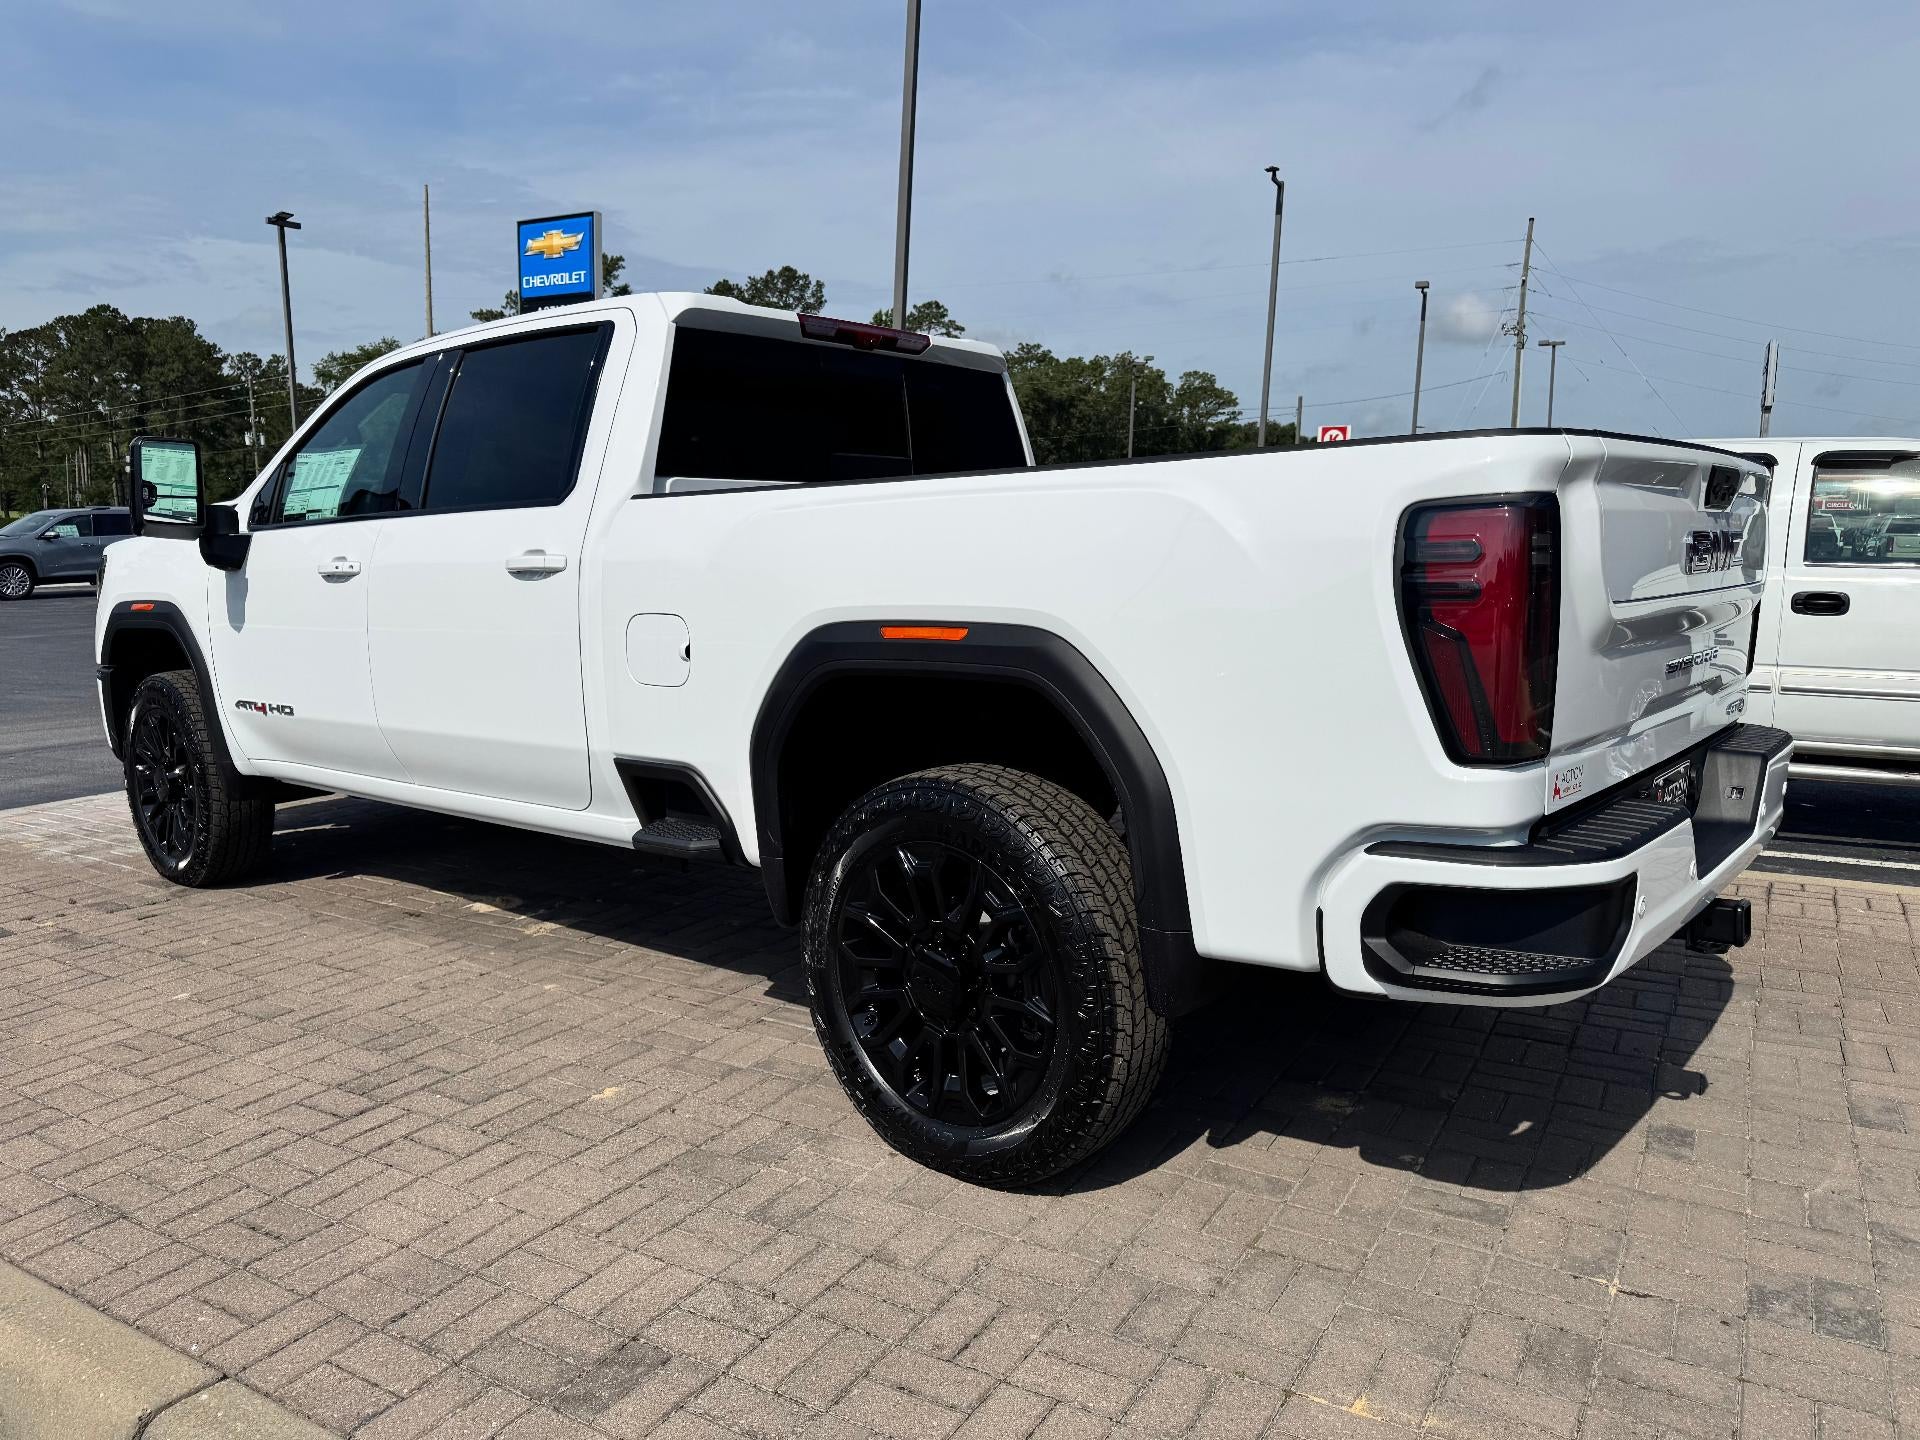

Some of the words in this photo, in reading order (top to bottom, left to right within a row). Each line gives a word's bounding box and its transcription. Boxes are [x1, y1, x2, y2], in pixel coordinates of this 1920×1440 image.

[522, 270, 587, 288] CHEVROLET
[234, 699, 267, 717] AT4
[268, 703, 294, 716] HD
